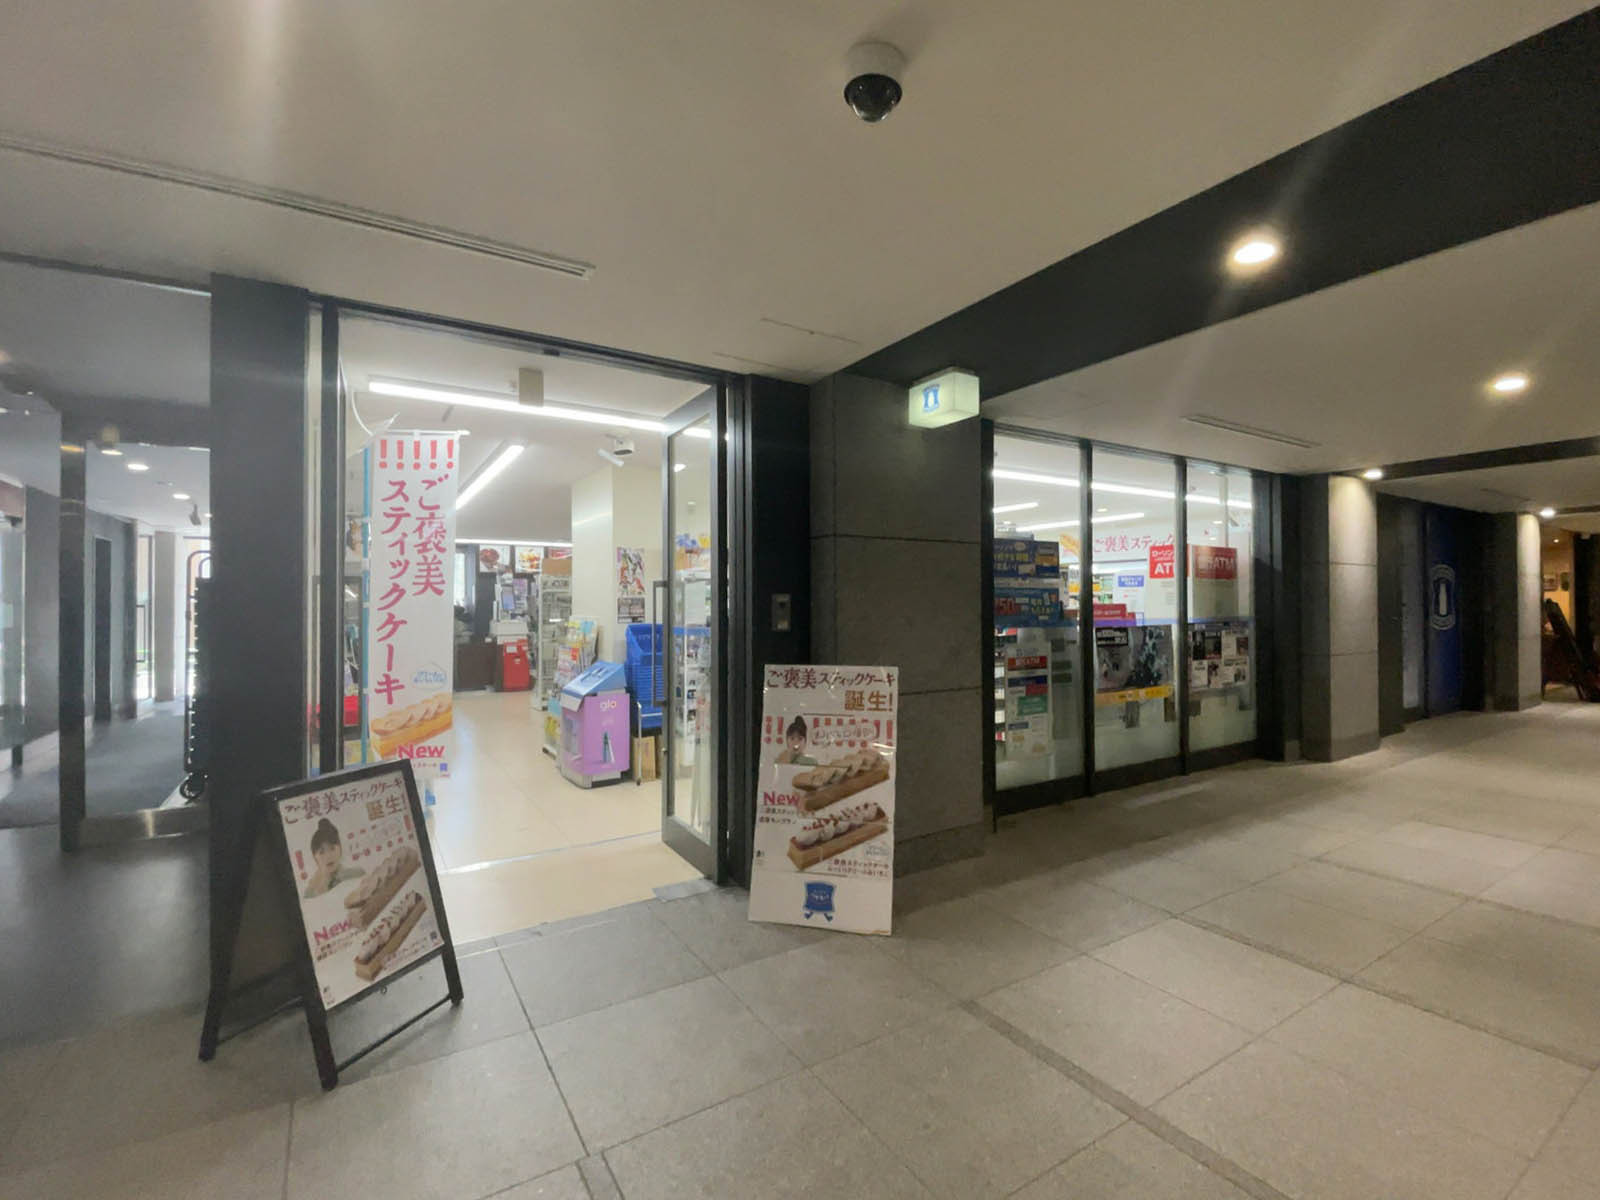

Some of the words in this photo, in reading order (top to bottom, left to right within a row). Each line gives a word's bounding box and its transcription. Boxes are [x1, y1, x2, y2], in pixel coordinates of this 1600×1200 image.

[412, 473, 449, 597] ご褒美
[374, 480, 411, 705] スティックケーキ
[766, 667, 896, 690] ご褒美スティックケーキ
[397, 742, 445, 760] New
[763, 791, 801, 806] New
[313, 920, 351, 944] New
